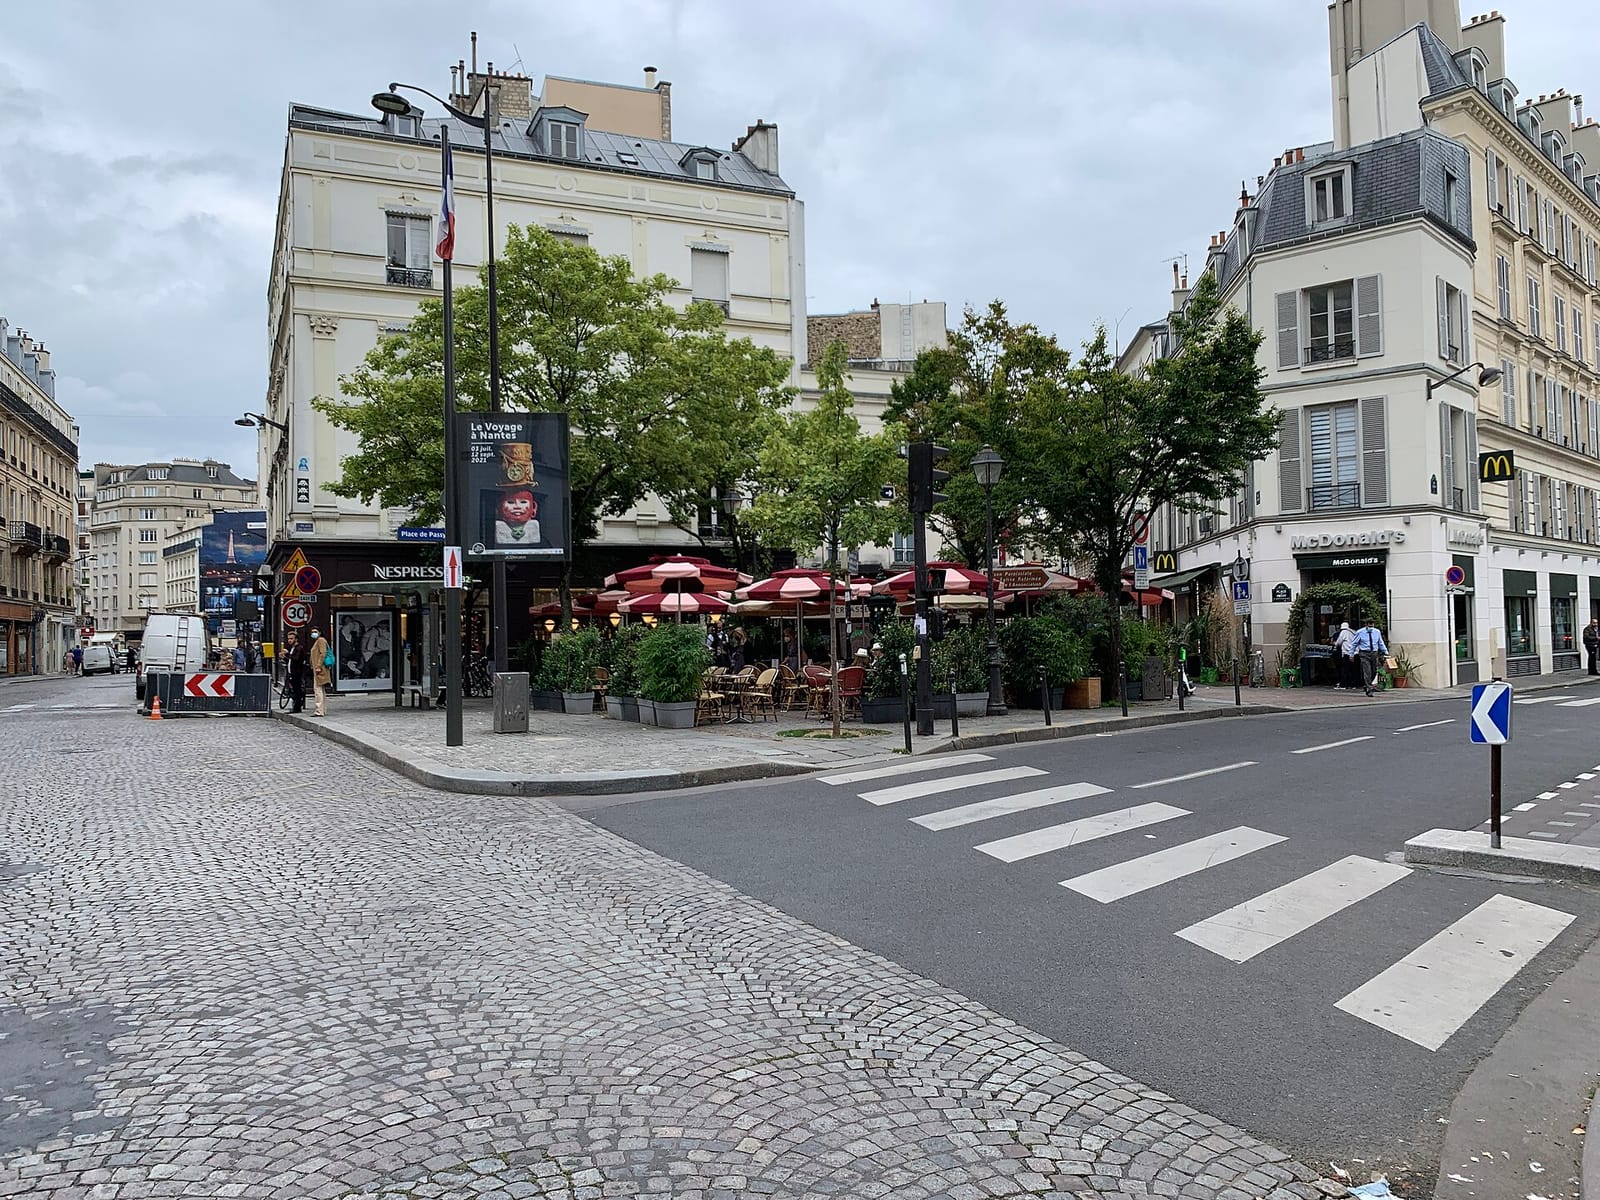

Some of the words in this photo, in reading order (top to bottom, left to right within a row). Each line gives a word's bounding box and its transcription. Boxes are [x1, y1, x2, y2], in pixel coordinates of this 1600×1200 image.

[471, 422, 483, 431] Le
[485, 422, 523, 433] Voyage
[471, 431, 477, 440] à
[480, 431, 517, 440] Nantes
[1291, 529, 1406, 550] McDonald's
[1332, 556, 1379, 567] McDonald's
[370, 563, 444, 580] NESPRESS
[288, 607, 306, 619] 30
